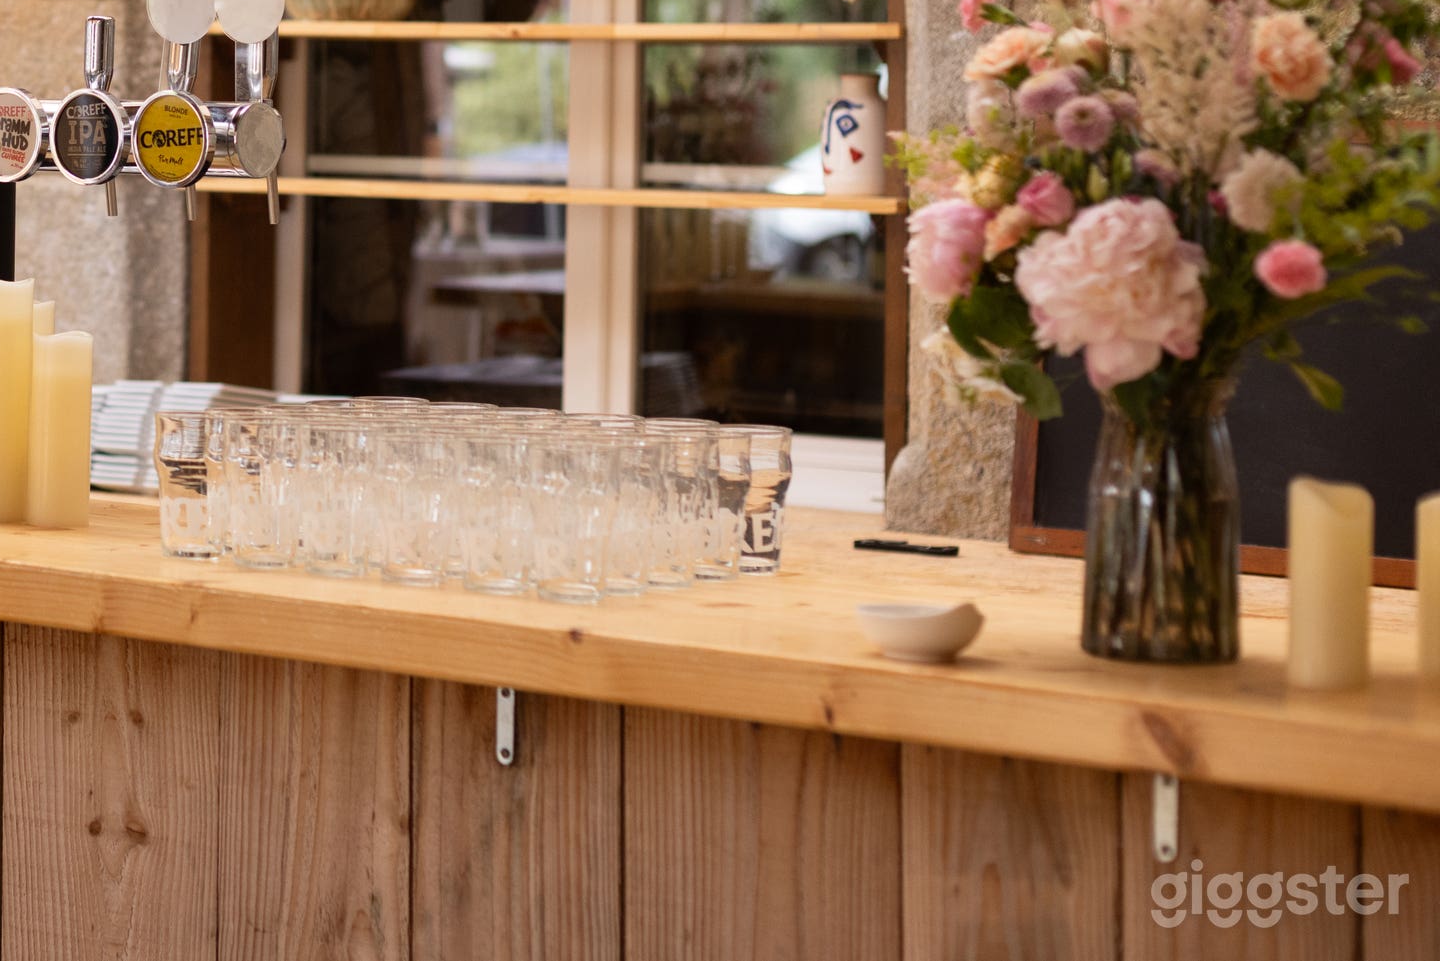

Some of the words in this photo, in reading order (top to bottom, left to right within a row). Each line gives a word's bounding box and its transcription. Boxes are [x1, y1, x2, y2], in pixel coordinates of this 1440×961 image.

[66, 102, 106, 119] COREFF
[164, 105, 189, 116] BLONDE
[1, 132, 28, 151] HUD
[68, 120, 106, 145] IPA
[141, 127, 204, 149] COREFF
